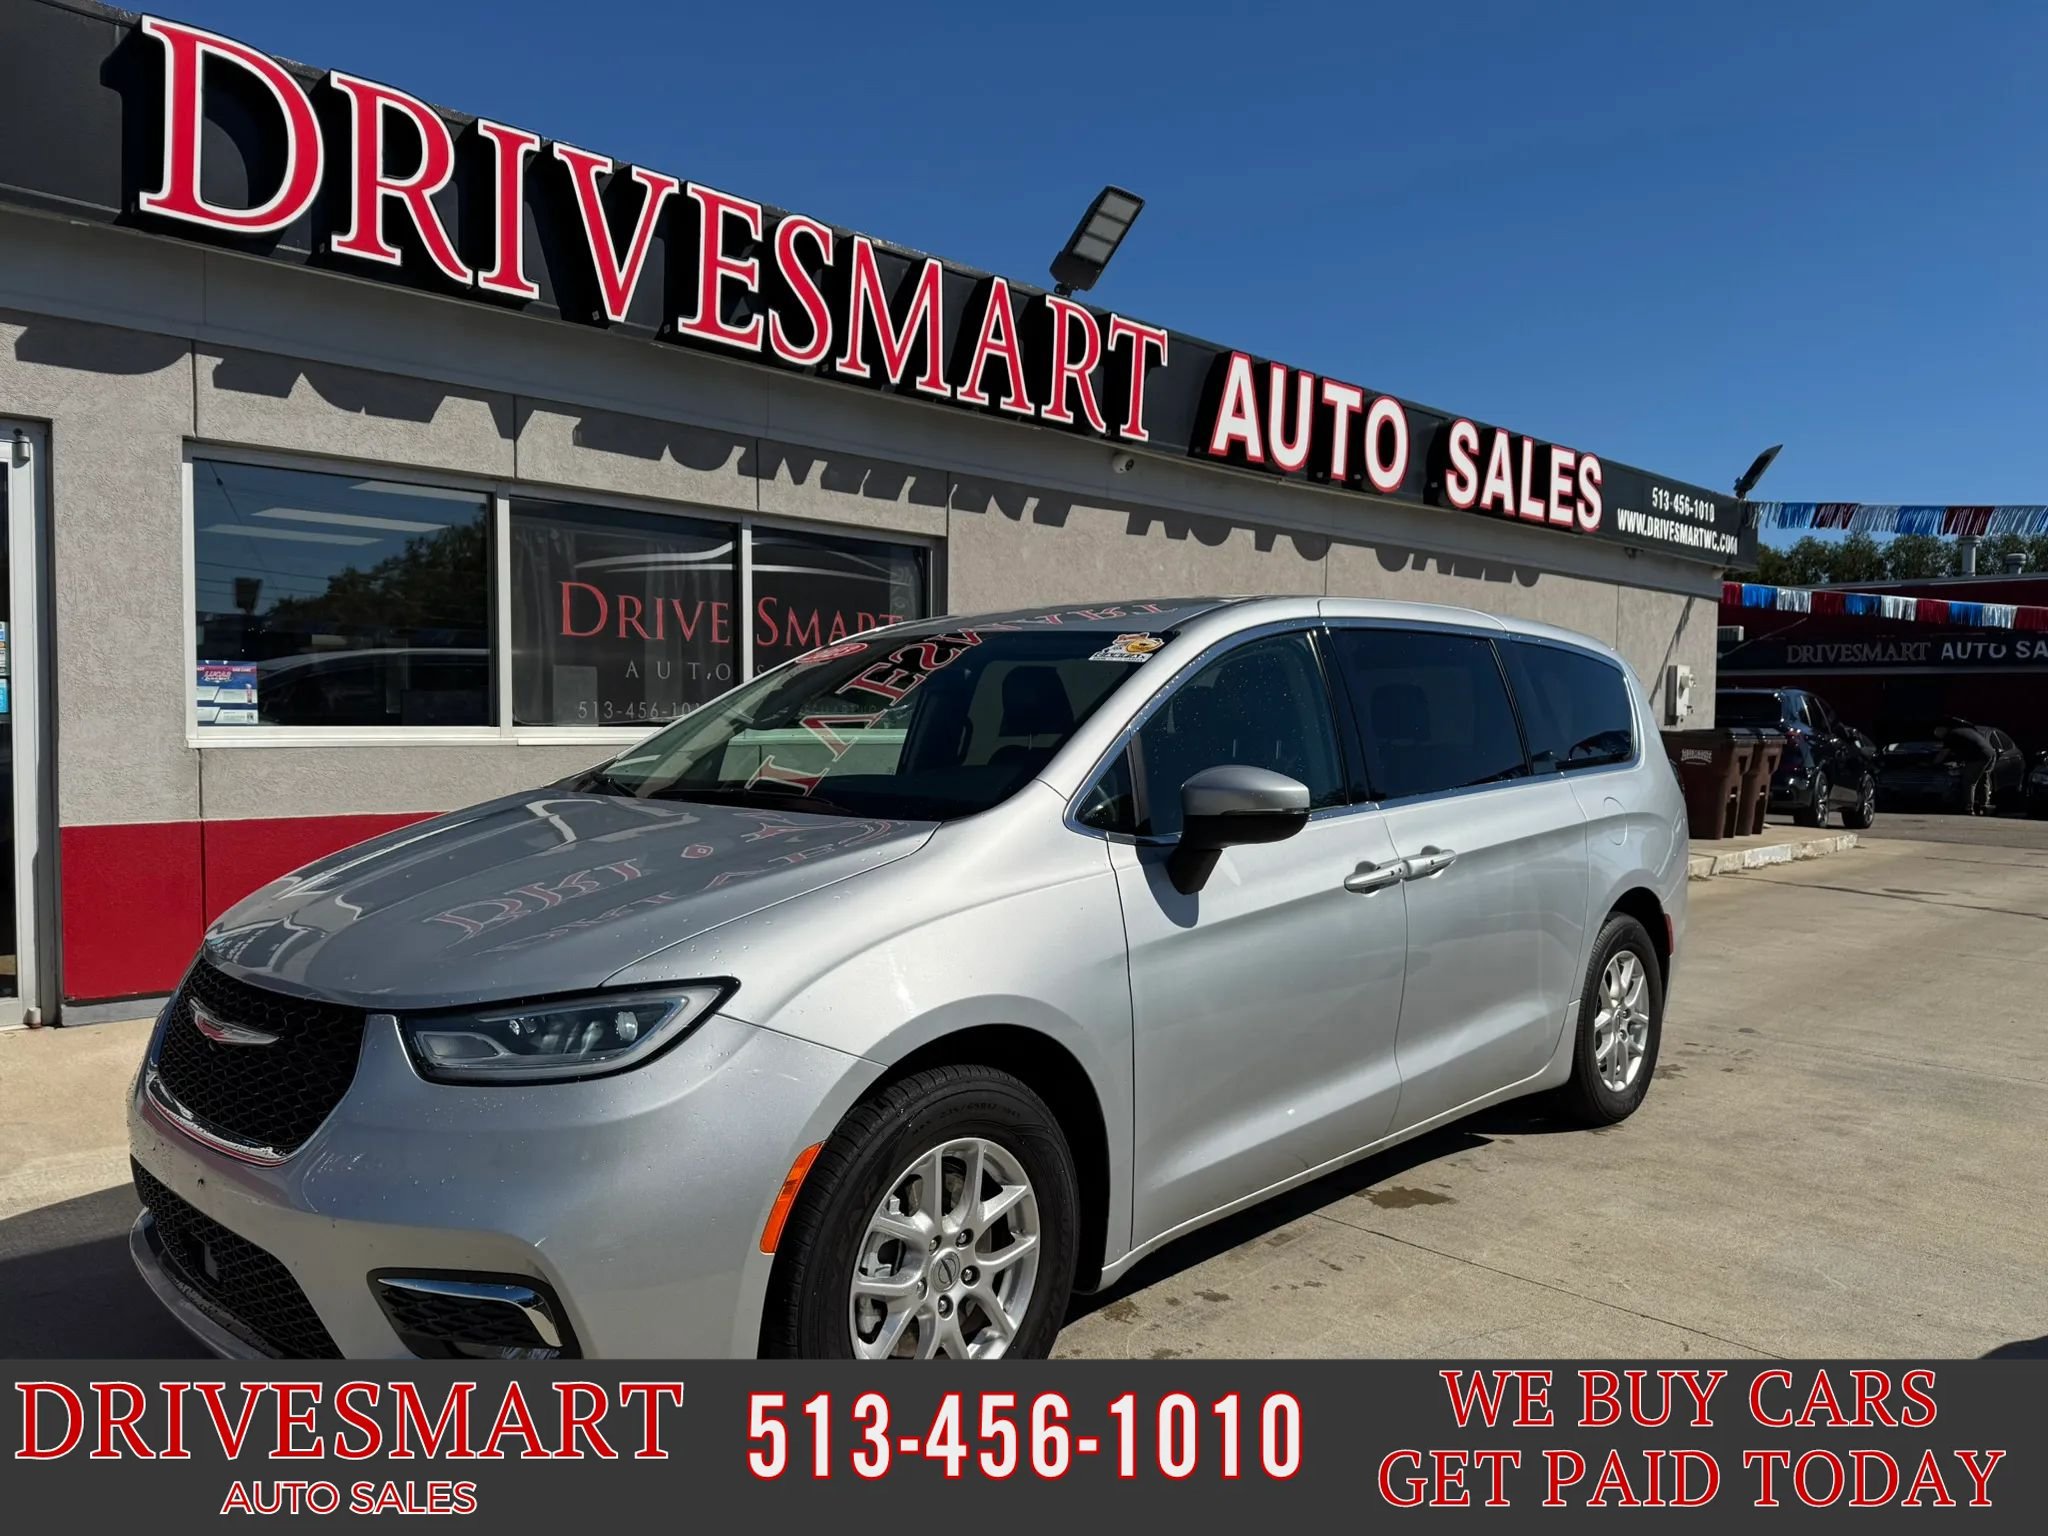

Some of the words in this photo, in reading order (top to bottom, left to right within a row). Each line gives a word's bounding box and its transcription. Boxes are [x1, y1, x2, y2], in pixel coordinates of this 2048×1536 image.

[139, 14, 1168, 442] DRIVESMART
[1208, 351, 1409, 493] AUTO
[1446, 418, 1602, 533] SALES
[1652, 486, 1715, 523] 513-456-1010
[1617, 507, 1738, 555] WWW.DRIVESMARTWC.COM
[559, 581, 730, 644] DRIVE
[625, 660, 731, 681] AUTO
[1786, 642, 1931, 663] DRIVESMART
[1941, 642, 2006, 660] AUTO
